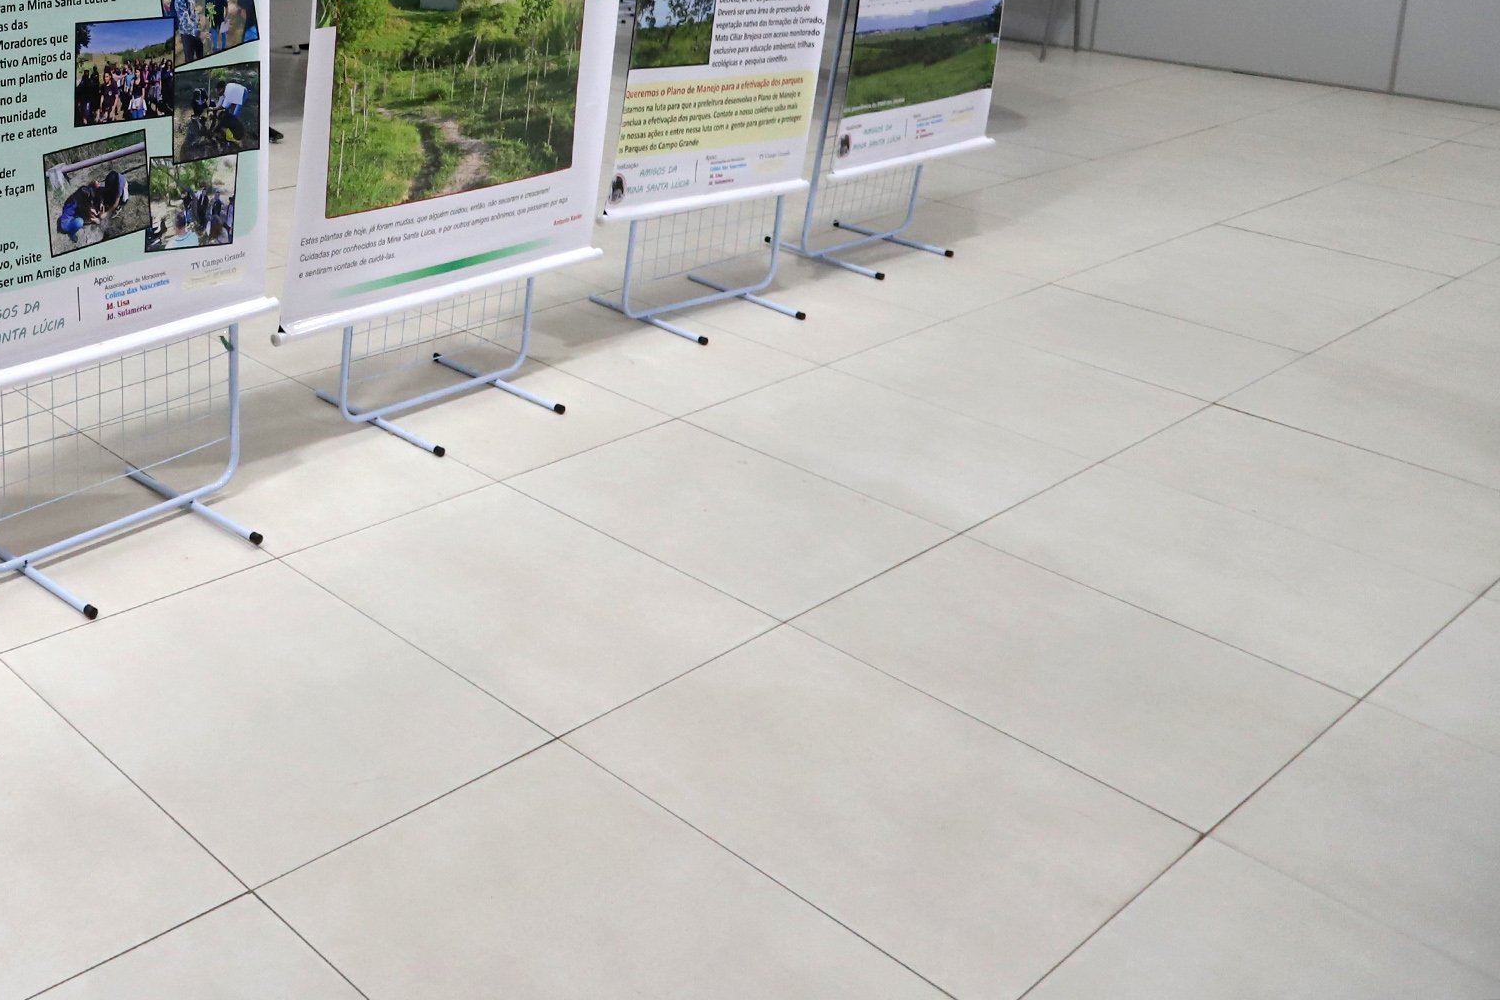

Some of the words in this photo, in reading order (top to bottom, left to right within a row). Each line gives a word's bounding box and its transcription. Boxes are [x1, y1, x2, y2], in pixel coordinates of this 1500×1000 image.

[191, 262, 201, 271] TV
[202, 257, 223, 268] Campo
[224, 250, 246, 262] Grande
[304, 266, 332, 278] sentiram
[334, 260, 358, 271] vontade
[359, 257, 367, 266] de
[93, 274, 115, 287] Apoio:
[104, 290, 125, 300] Colina
[127, 286, 138, 295] das
[139, 279, 170, 291] Nascentes
[23, 301, 40, 315] DA
[32, 318, 65, 336] LÚCIA
